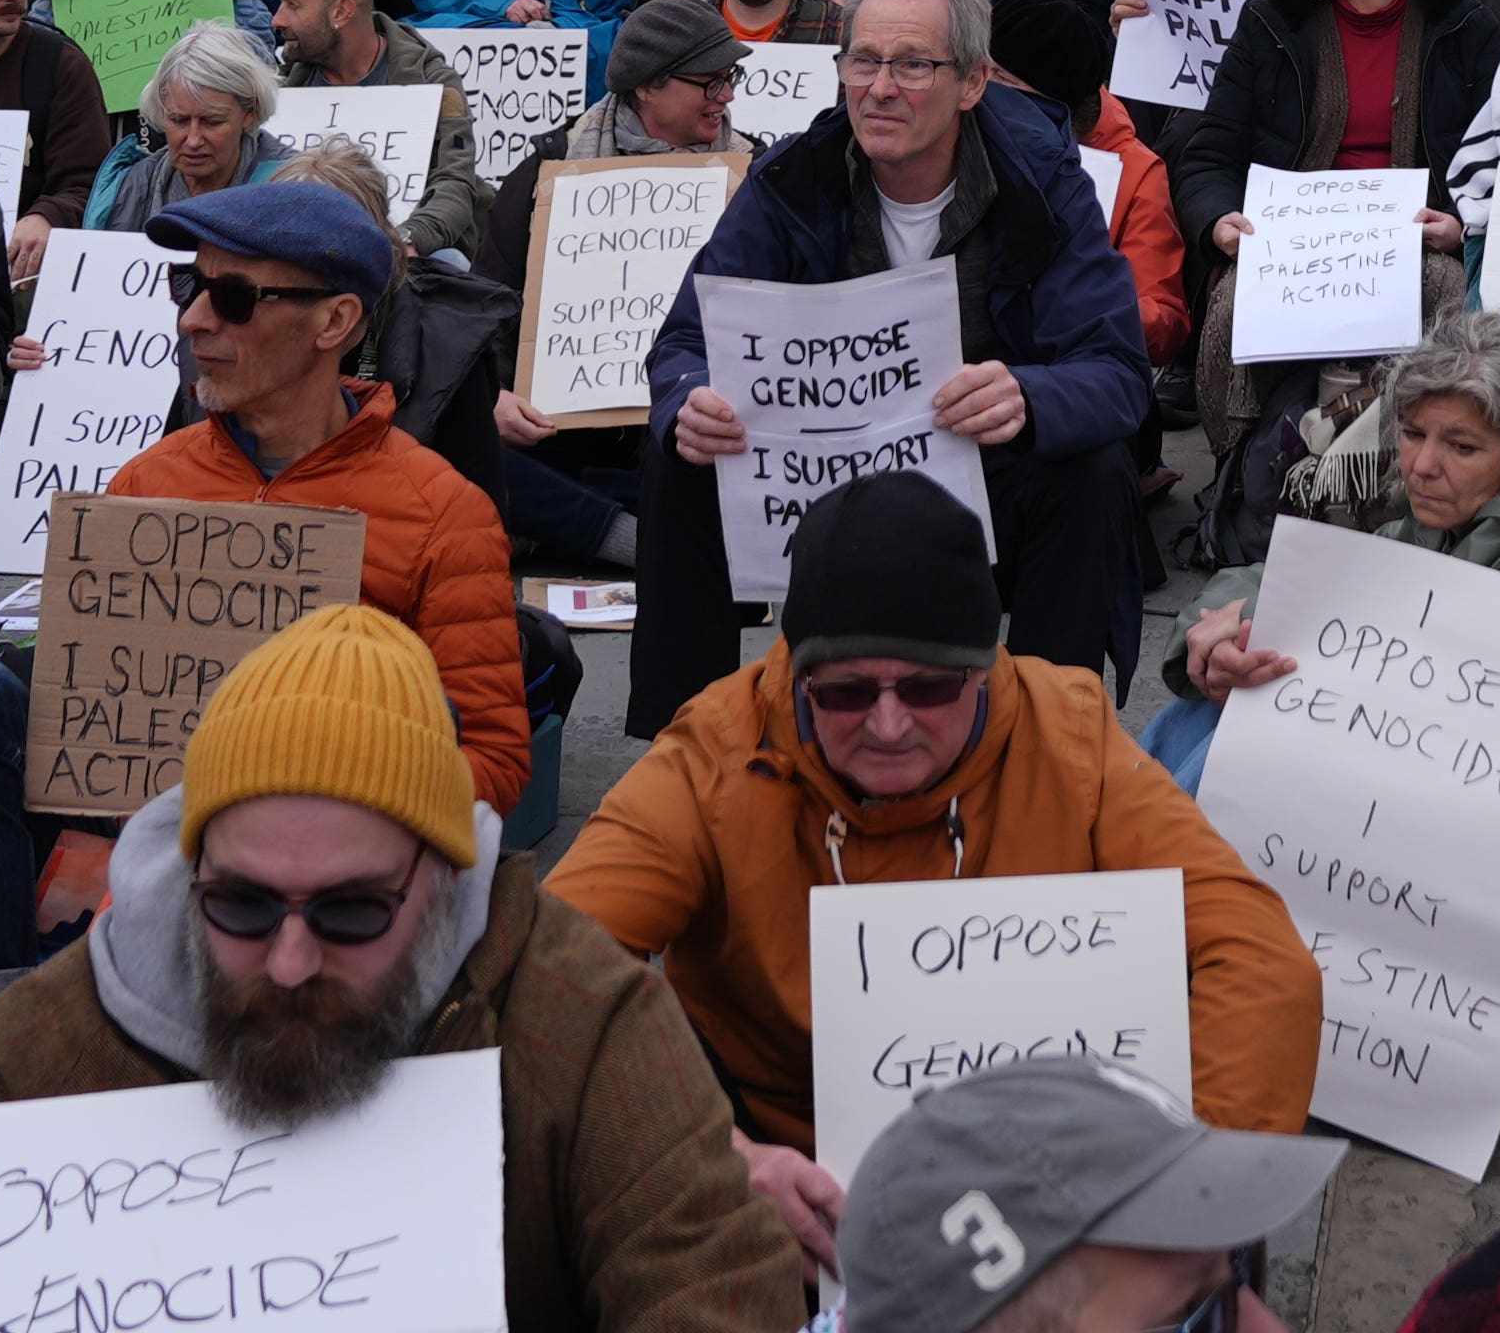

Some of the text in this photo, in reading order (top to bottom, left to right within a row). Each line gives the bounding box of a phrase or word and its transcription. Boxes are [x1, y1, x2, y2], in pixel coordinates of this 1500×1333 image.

[1297, 179, 1384, 196] OPPOSE
[1290, 227, 1401, 249] SUPPORT
[1259, 249, 1396, 281] PALESTINE
[1282, 277, 1380, 305] ACTION.
[742, 319, 910, 368] I OPPOSE
[752, 358, 921, 408] GENOCIDE
[753, 432, 934, 485] I SUPPORT
[68, 507, 325, 575] I OPPOSE
[68, 568, 322, 631] GENOCIDE
[1420, 589, 1433, 629] I
[858, 909, 1132, 995] I OPPOSE
[938, 1186, 1026, 1291] 3
